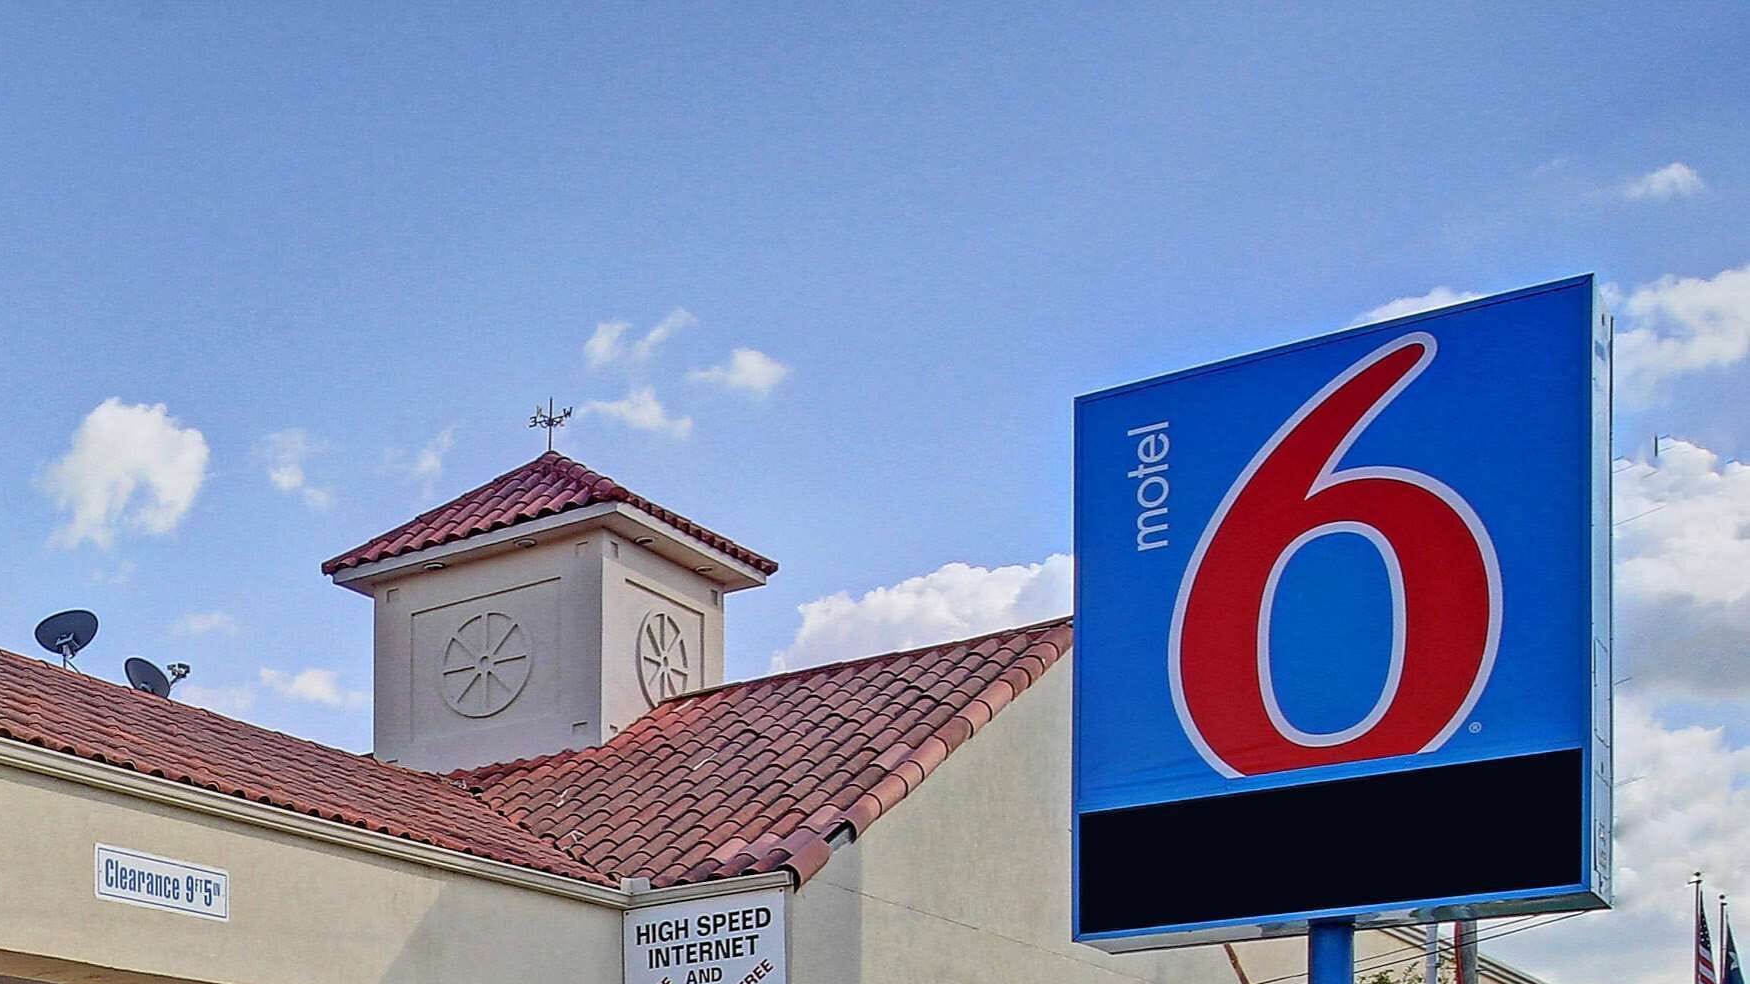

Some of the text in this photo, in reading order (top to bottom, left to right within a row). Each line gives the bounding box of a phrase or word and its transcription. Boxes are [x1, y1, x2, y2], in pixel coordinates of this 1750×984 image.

[1127, 421, 1170, 551] motel
[1168, 331, 1503, 779] 6
[105, 858, 180, 900] Clearance
[636, 907, 771, 945] HIGH SPEED
[649, 934, 759, 969] INTERNET
[686, 967, 722, 984] AND
